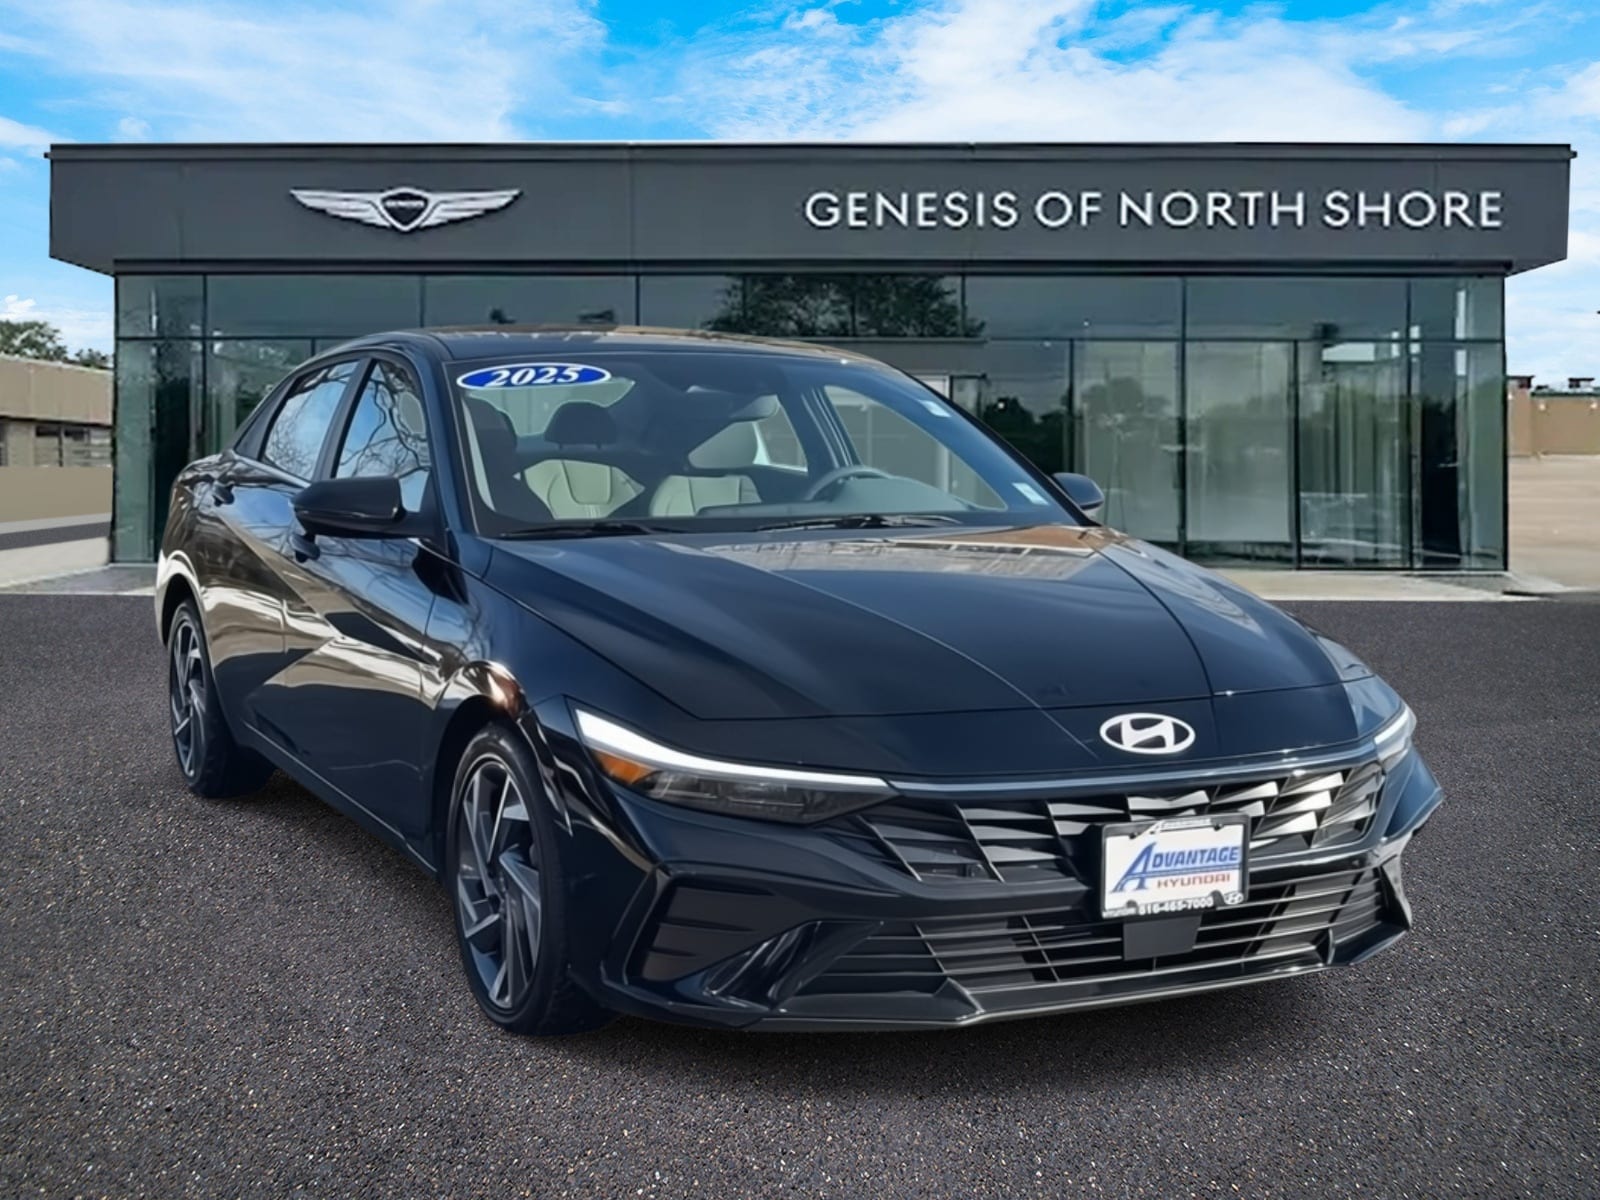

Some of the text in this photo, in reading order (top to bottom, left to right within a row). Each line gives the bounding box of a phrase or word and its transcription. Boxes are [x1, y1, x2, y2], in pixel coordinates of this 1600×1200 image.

[805, 191, 1502, 227] GENESIS OF NORTH SHORE
[485, 367, 583, 387] 2025
[1110, 842, 1241, 894] ADVANTAGE
[1157, 873, 1231, 889] HYUNDAI
